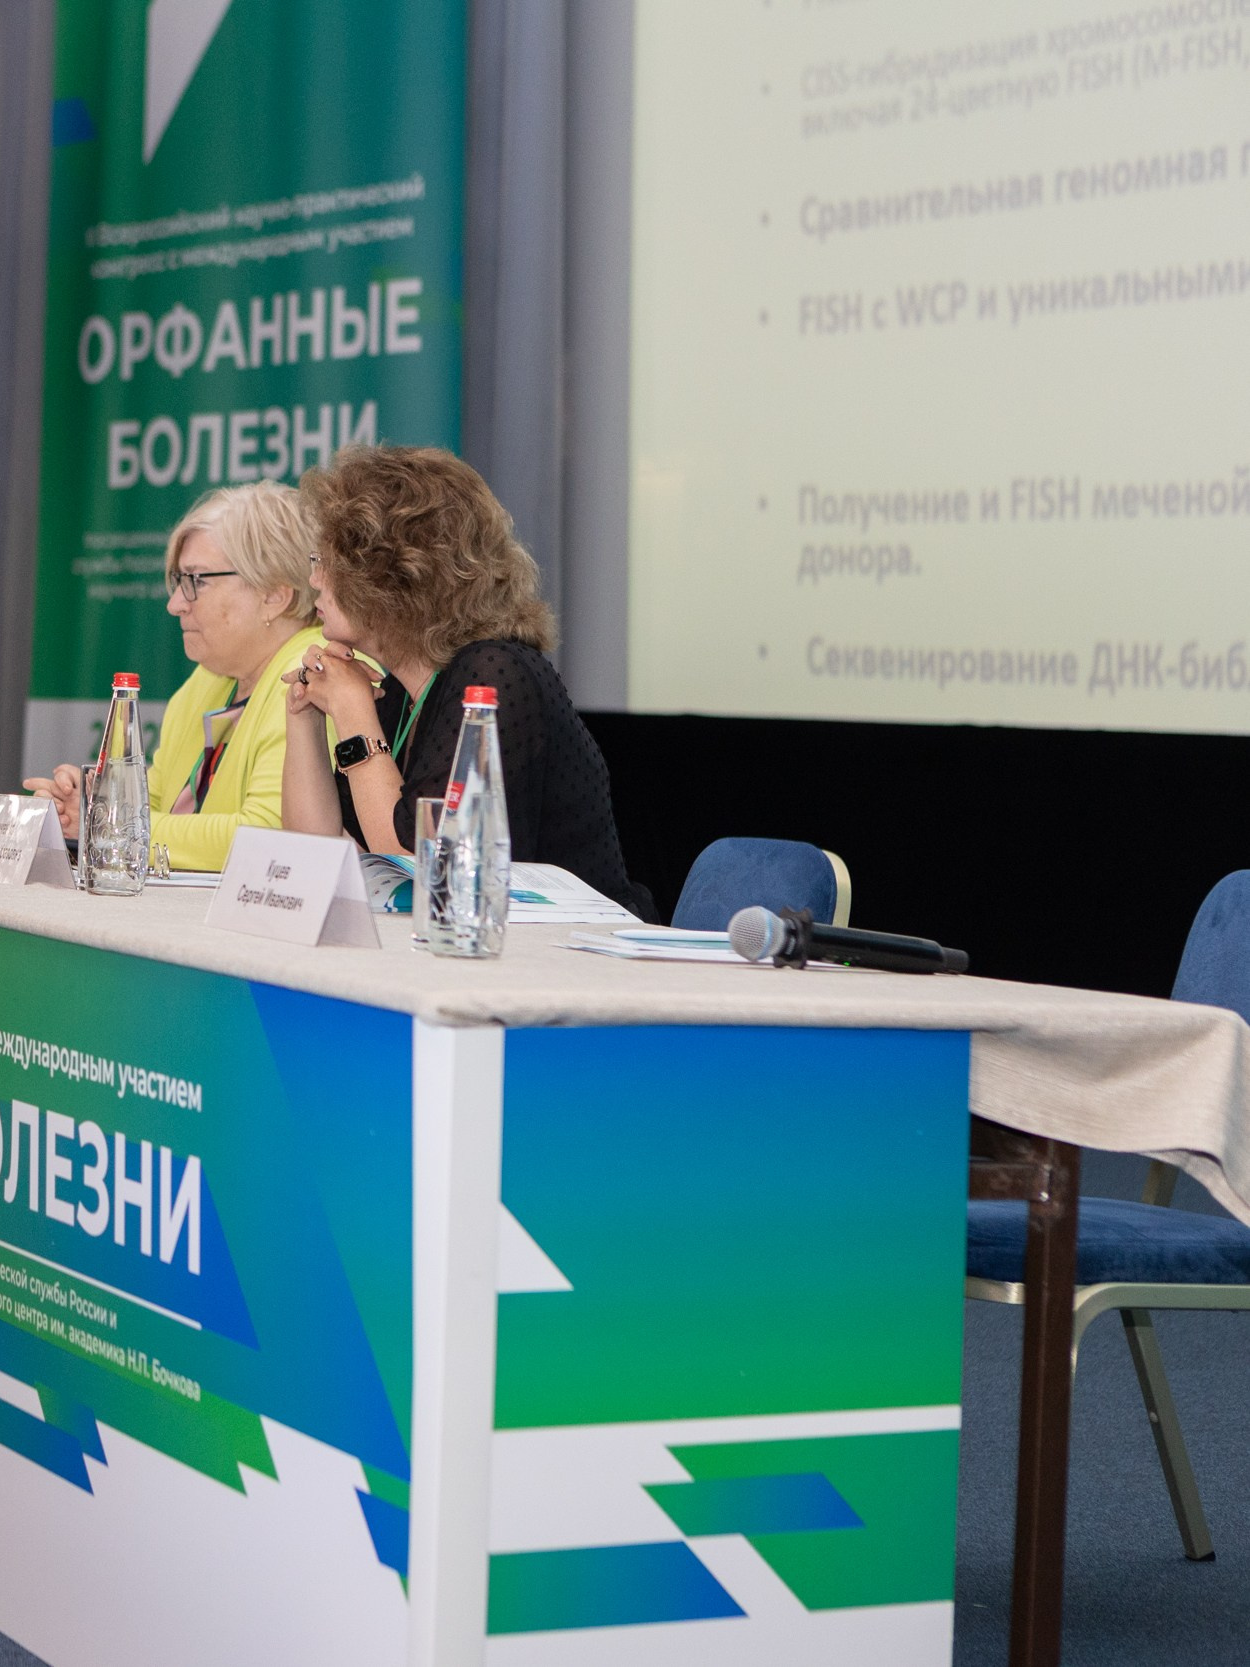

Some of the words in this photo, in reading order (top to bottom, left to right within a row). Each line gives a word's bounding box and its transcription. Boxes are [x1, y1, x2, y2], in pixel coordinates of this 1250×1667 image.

[1066, 51, 1125, 93] FISH
[799, 172, 1044, 243] Сравнительная
[1053, 145, 1228, 202] геномная
[79, 278, 423, 384] ОРФАННЫЕ
[798, 294, 863, 336] FISH
[895, 280, 969, 328] WCP
[976, 286, 998, 320] и
[107, 401, 377, 489] БОЛЕЗНИ
[798, 484, 971, 533] Получение
[980, 488, 1000, 523] и
[1010, 475, 1082, 522] FISH
[1091, 465, 1250, 521] меченой
[796, 543, 922, 585] донора.
[806, 635, 1079, 690] Секвенирование
[1088, 640, 1250, 697] ДНК-биб
[117, 1062, 203, 1113] участием
[30, 1276, 67, 1308] службы
[70, 1289, 107, 1326] России
[109, 1312, 118, 1330] и
[14, 1300, 48, 1331] центра
[50, 1315, 67, 1339] им.
[68, 1324, 126, 1367] академика
[127, 1346, 150, 1379] Н.П.
[152, 1357, 201, 1402] Бочкова
